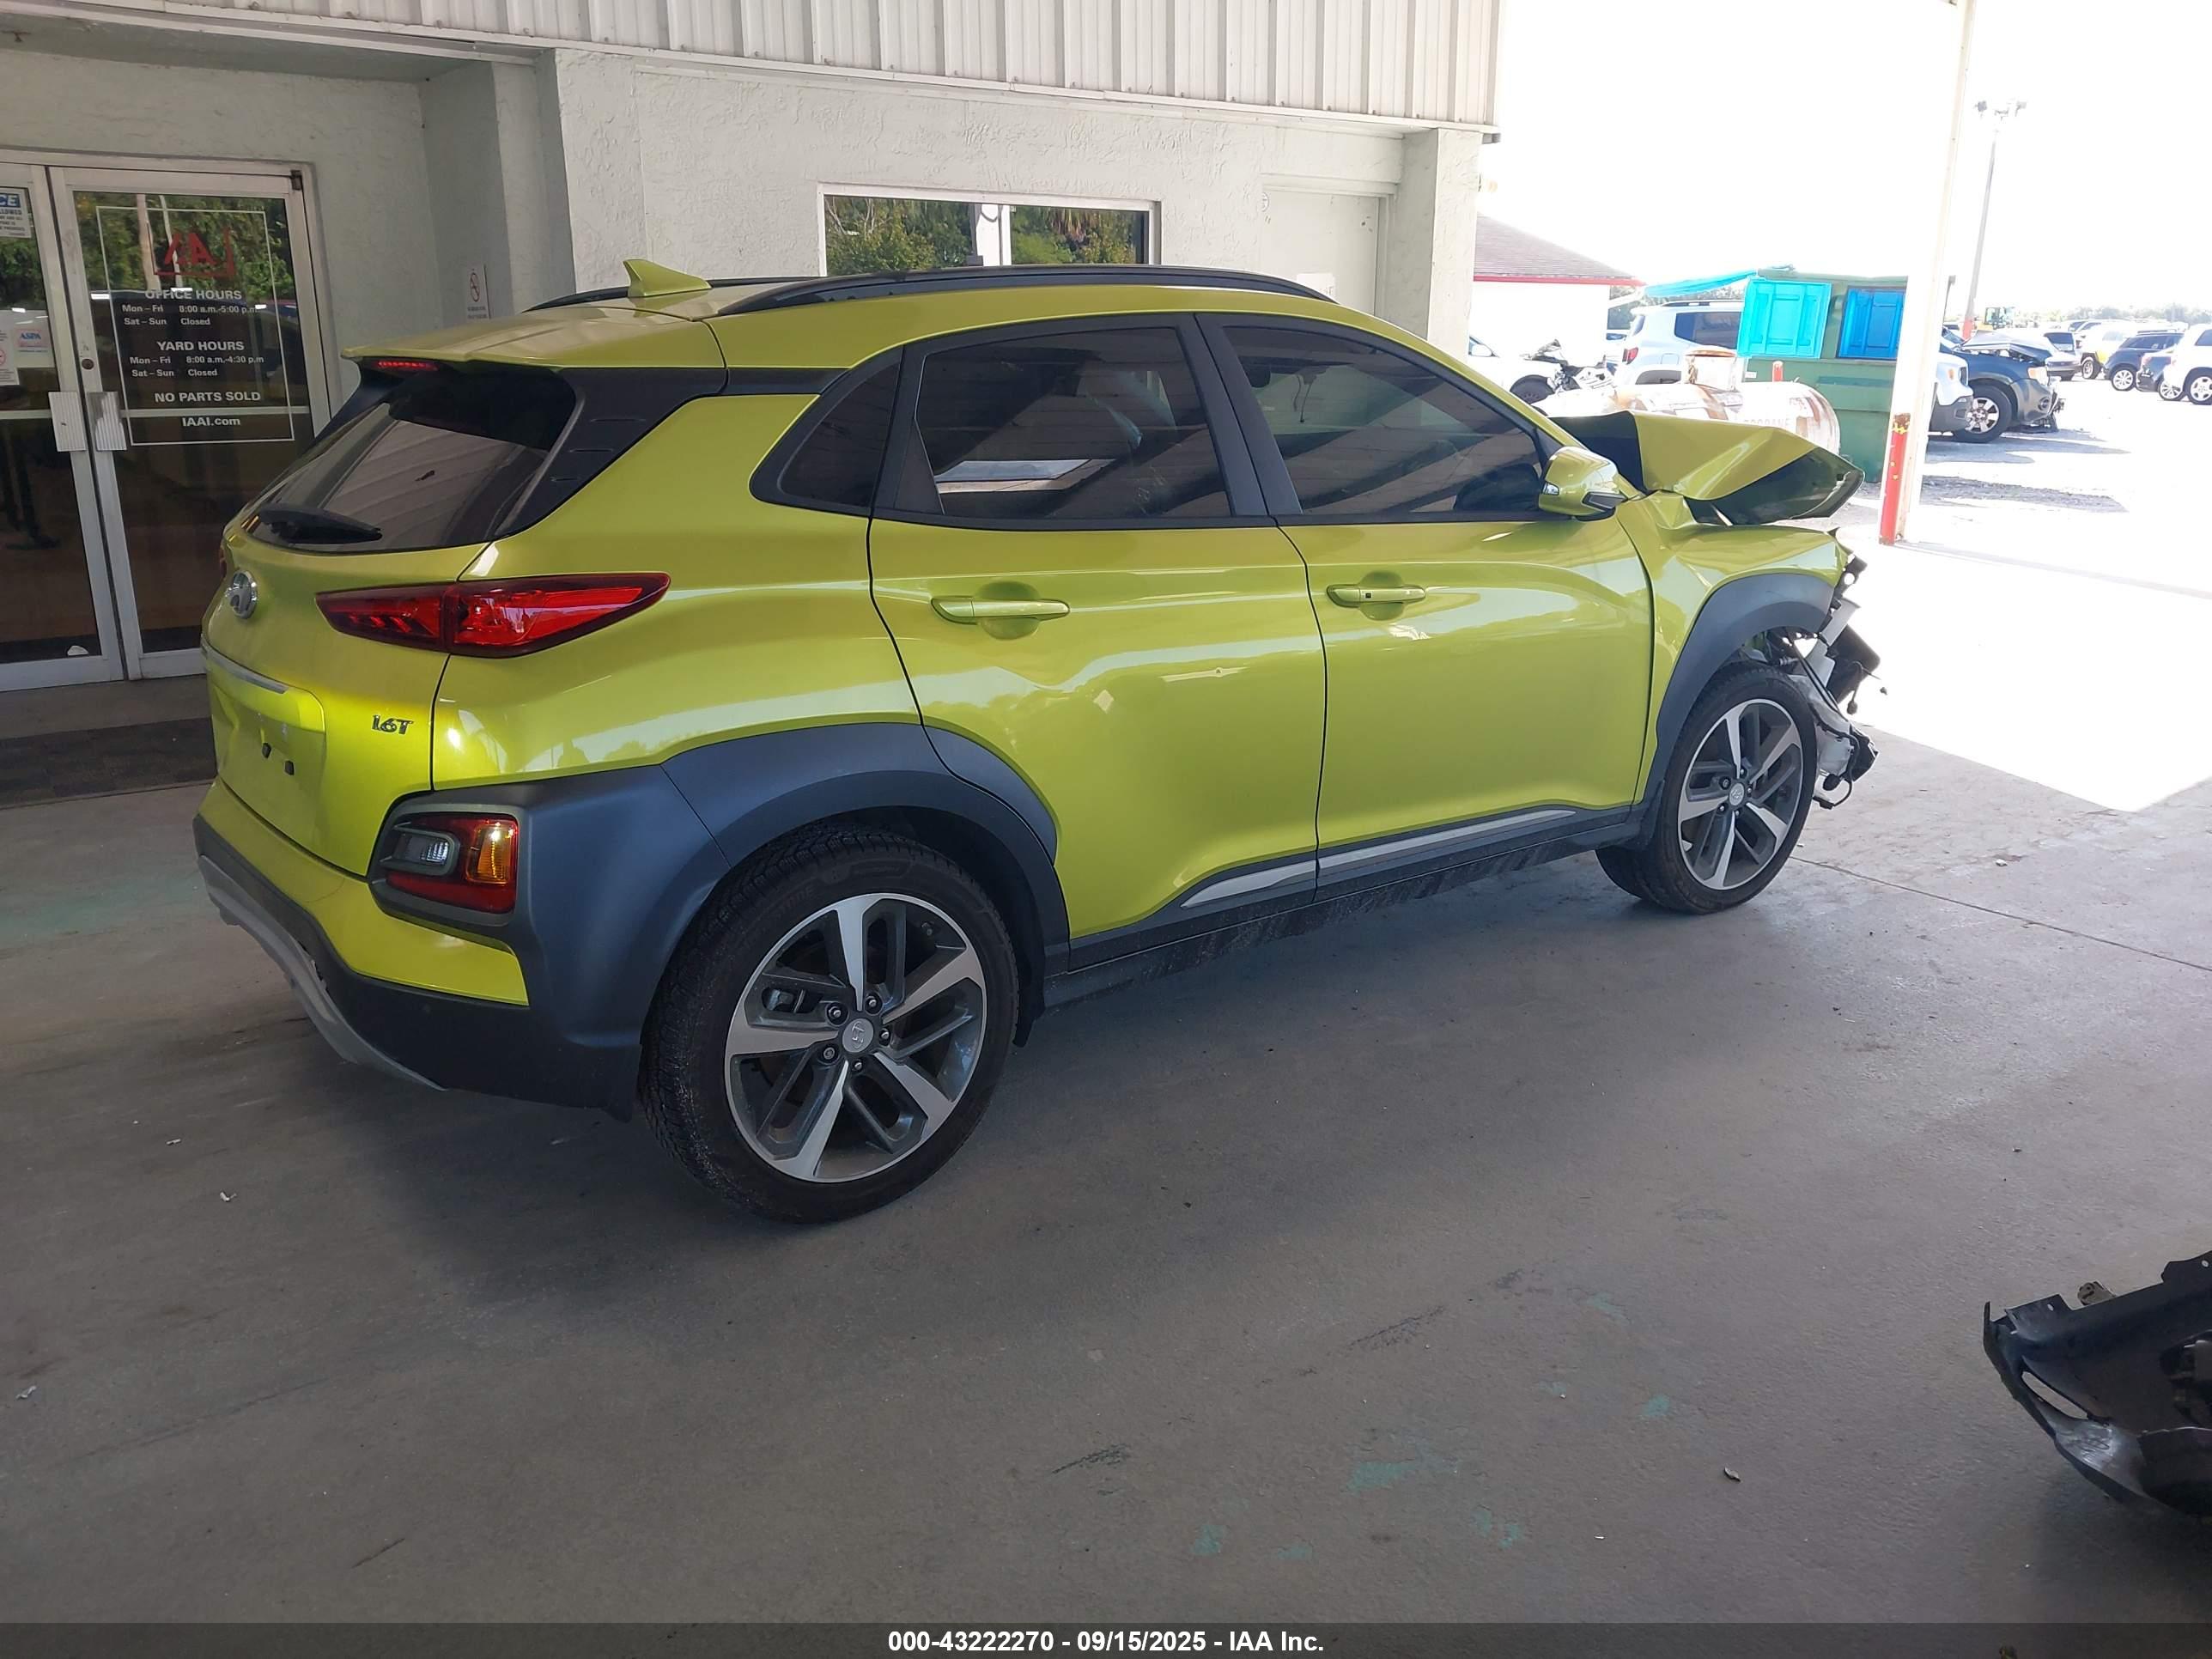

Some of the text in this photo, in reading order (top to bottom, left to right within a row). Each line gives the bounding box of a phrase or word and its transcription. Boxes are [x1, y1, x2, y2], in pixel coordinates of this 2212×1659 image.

[145, 289, 242, 300] OFFICE HOURS
[122, 304, 143, 313] Mon
[152, 304, 163, 313] Fri
[157, 341, 245, 351] YARD HOURS
[188, 368, 217, 377] Closed
[155, 392, 261, 403] NO PARTS SOLD
[182, 416, 241, 427] IAAI.com
